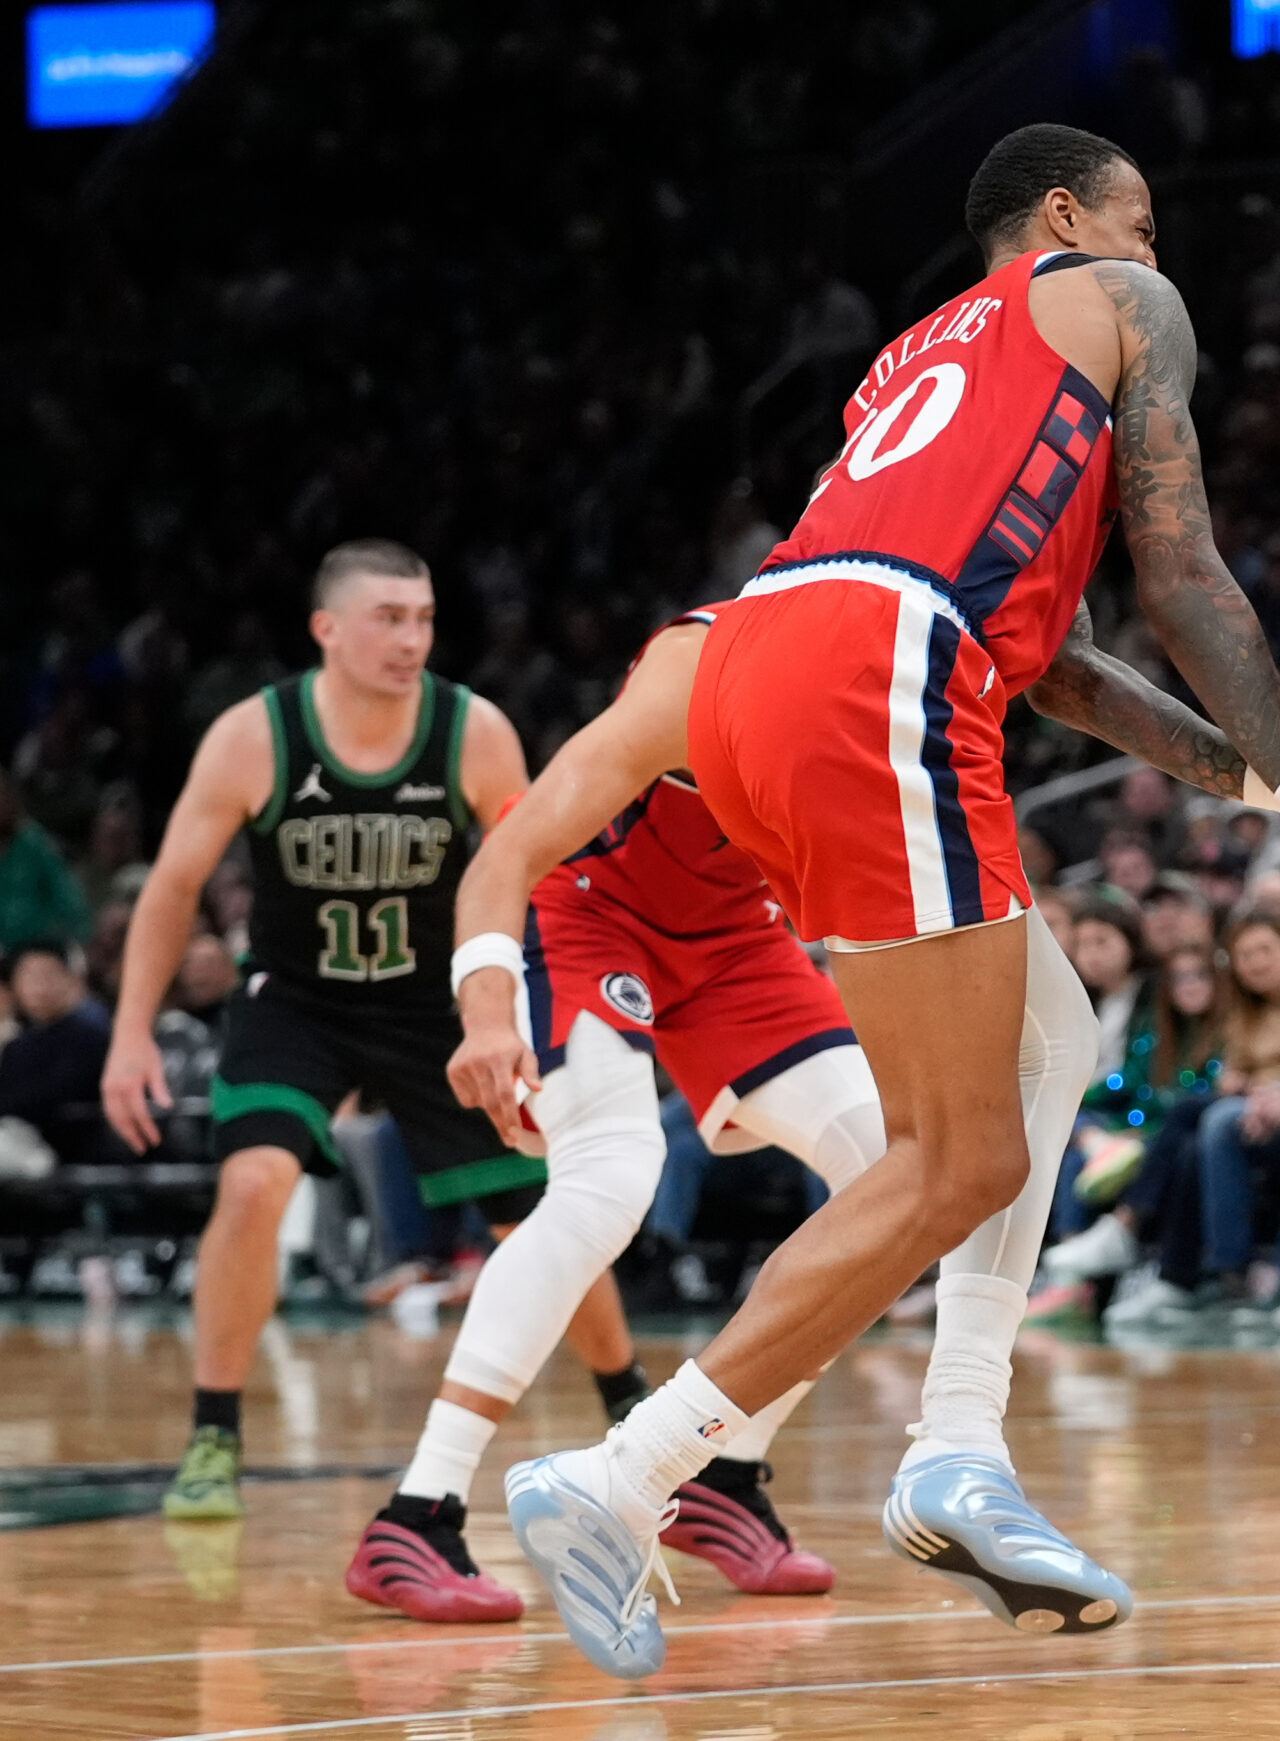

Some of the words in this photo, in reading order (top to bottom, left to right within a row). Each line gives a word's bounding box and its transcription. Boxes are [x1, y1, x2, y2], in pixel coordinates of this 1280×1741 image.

[853, 297, 1002, 412] COLLINS
[277, 813, 452, 890] CELTICS
[317, 896, 416, 982] 11
